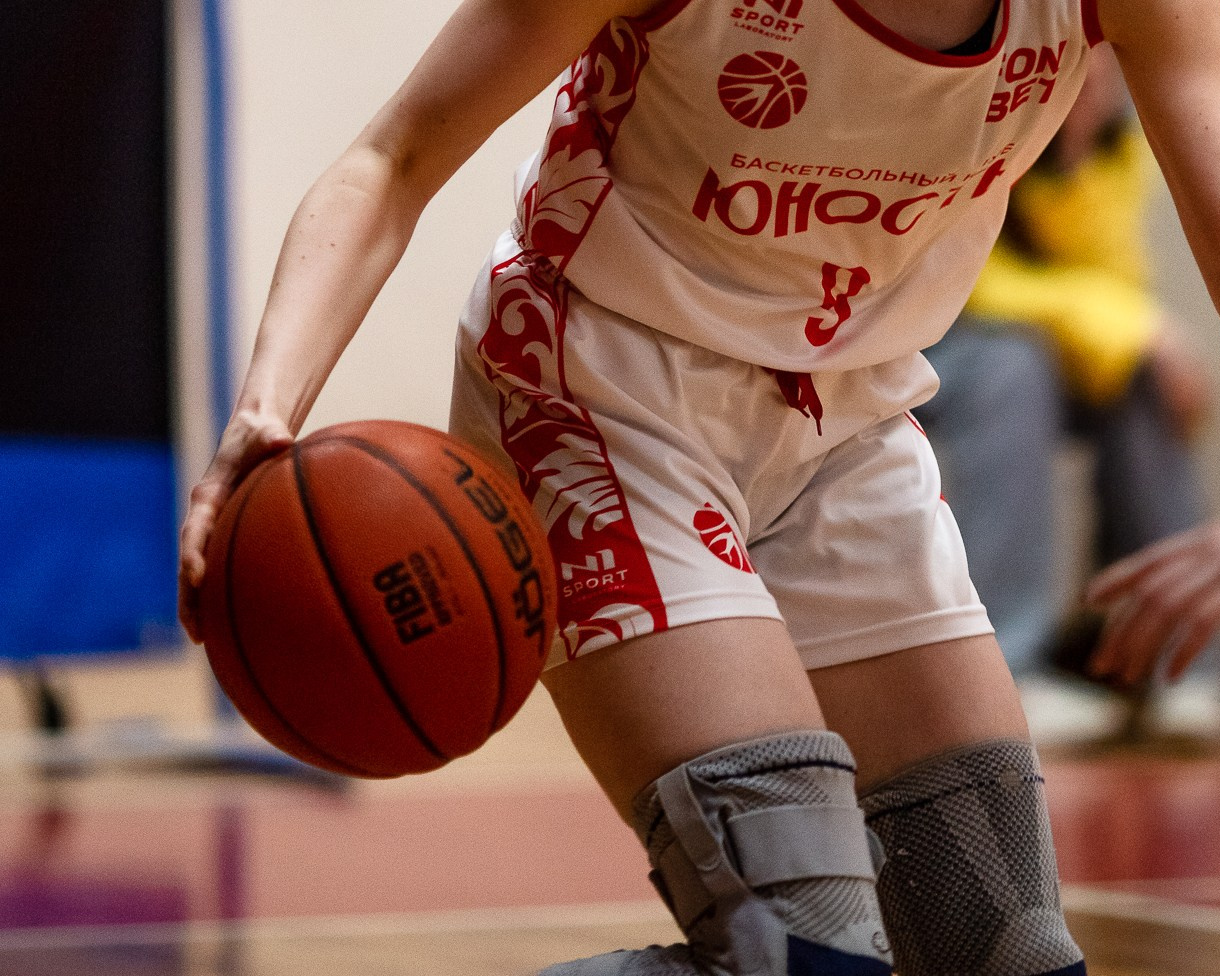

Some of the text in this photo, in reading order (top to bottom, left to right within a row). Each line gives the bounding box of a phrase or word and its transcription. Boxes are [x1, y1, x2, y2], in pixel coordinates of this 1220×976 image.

[730, 7, 805, 35] SPORT
[984, 76, 1057, 123] BET
[730, 152, 958, 187] БАСКЕТБОЛЬНЫЙ
[562, 569, 628, 598] SPORT
[372, 559, 435, 646] FIBA
